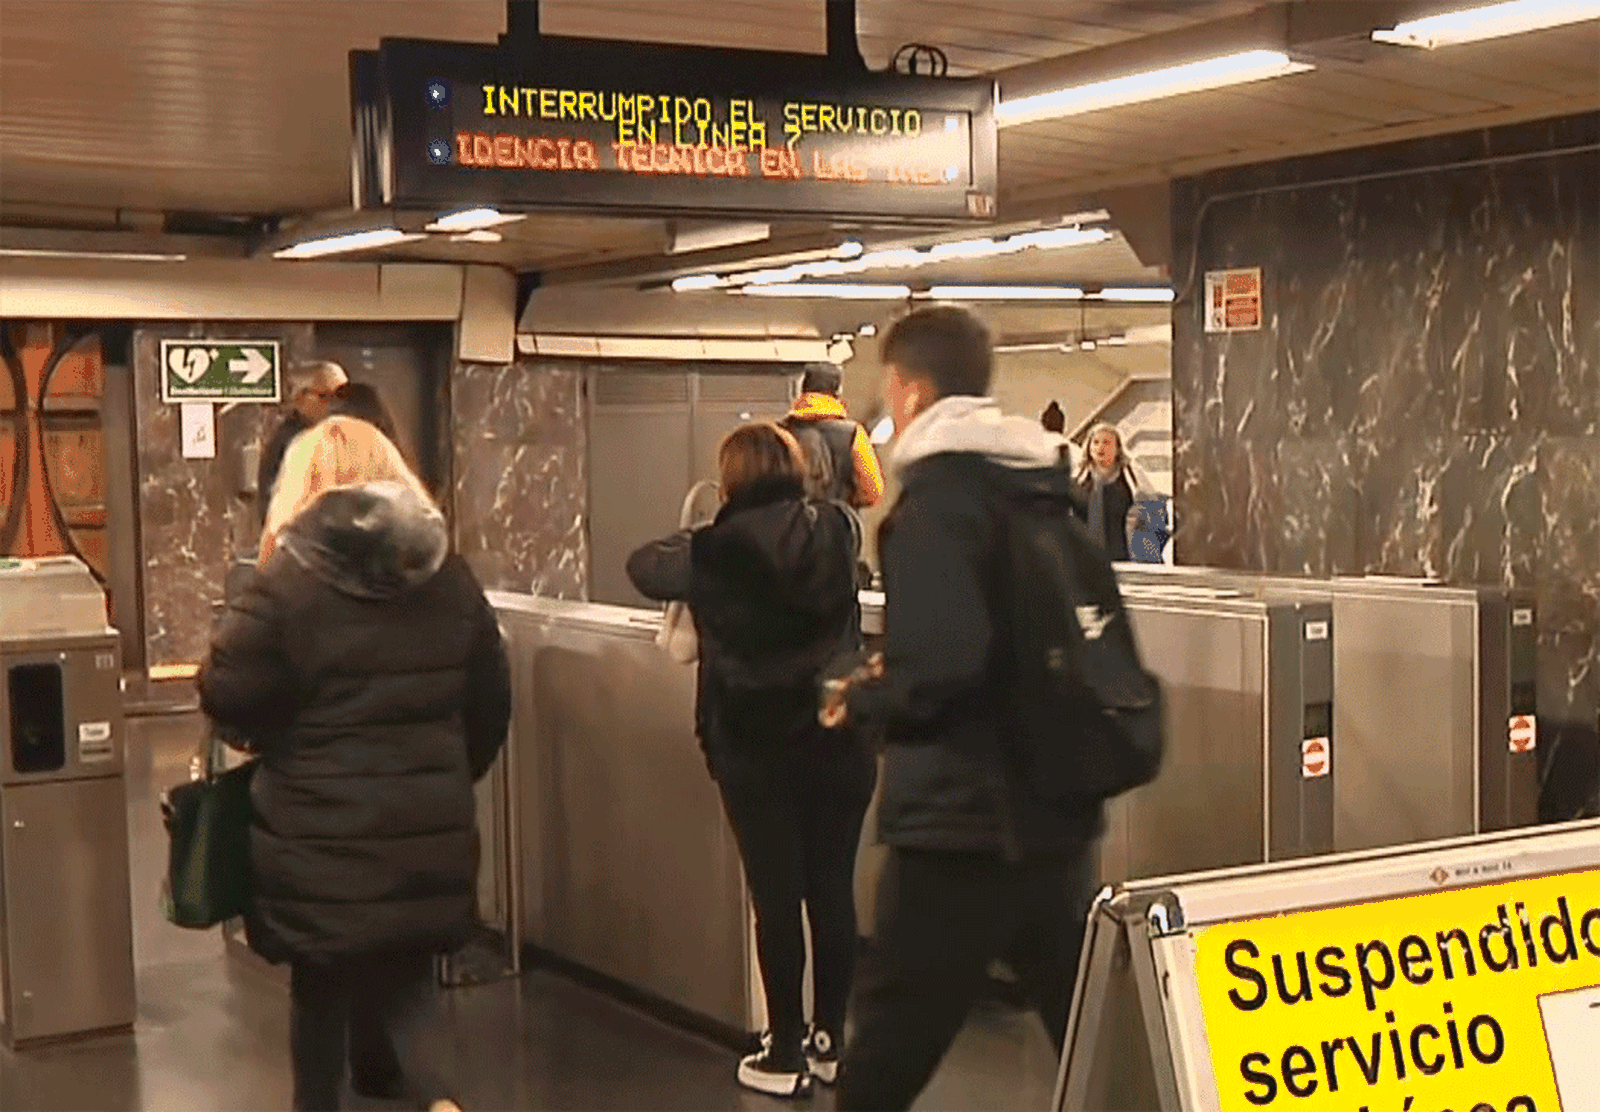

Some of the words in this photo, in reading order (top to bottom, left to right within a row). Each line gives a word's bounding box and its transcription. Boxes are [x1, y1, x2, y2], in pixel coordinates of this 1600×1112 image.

[482, 85, 711, 127] INTERRUMPIDO
[731, 99, 766, 128] EL
[783, 102, 922, 138] SERVICIO
[456, 132, 599, 170] IDENCIA
[619, 119, 657, 147] EN
[674, 120, 767, 152] LINEA
[1239, 1000, 1505, 1106] servicio
